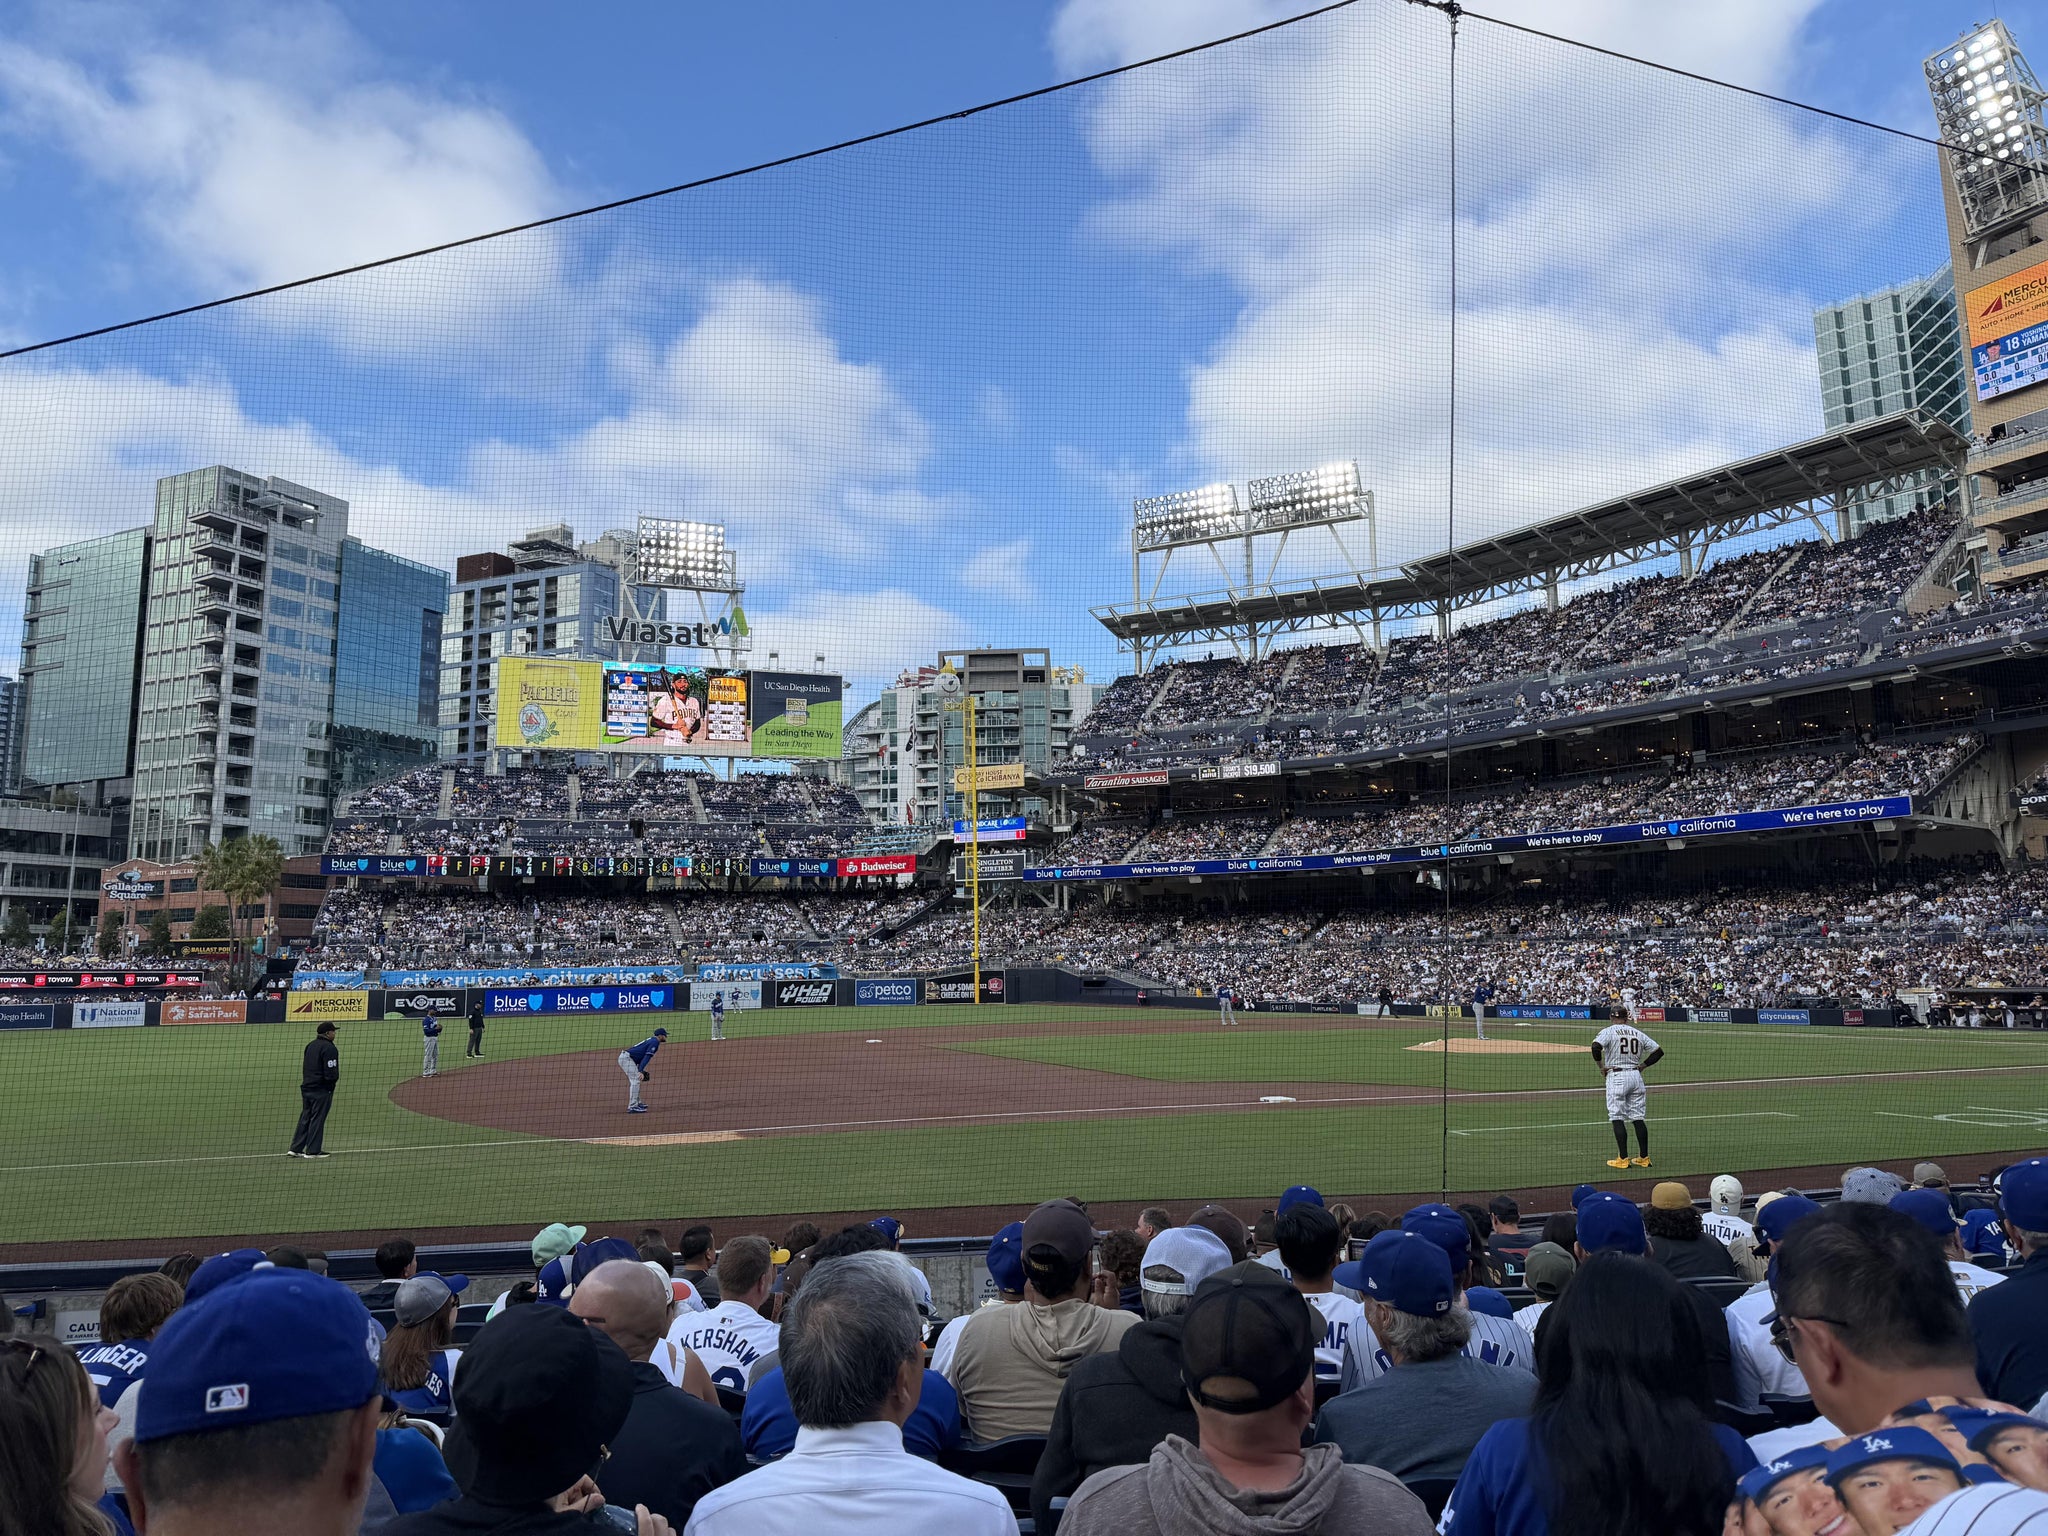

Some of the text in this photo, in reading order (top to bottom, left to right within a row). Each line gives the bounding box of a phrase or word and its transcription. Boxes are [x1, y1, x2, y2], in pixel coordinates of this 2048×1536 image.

[2005, 336, 2020, 352] 18
[1984, 371, 1997, 382] 0.0
[1994, 373, 2036, 395] 3 3
[607, 616, 708, 646] Viasat
[764, 682, 776, 690] UC
[790, 683, 808, 693] Diego
[809, 684, 830, 693] Health
[765, 728, 834, 740] Leading the Way
[792, 740, 812, 748] Diego
[1244, 763, 1276, 776] $19,500
[986, 773, 1020, 782] ICHIBANYA
[1086, 774, 1166, 788] Tarantino SAUSAGES
[1782, 804, 1885, 823] We're here to play
[1642, 818, 1736, 837] blue california
[1526, 832, 1602, 847] We're here to play
[1420, 841, 1492, 857] blue california
[442, 857, 448, 866] 2
[484, 857, 490, 866] 9
[527, 857, 532, 866] 2
[568, 857, 574, 866] 3
[608, 857, 614, 866] 6
[648, 858, 654, 867] 3
[725, 858, 730, 867] 0
[1333, 852, 1391, 864] We're here to play
[331, 859, 357, 868] blue
[380, 859, 405, 869] blue
[457, 861, 462, 871] F
[499, 861, 505, 871] F
[541, 861, 547, 871] F
[582, 862, 588, 871] 6
[622, 862, 628, 872] 6
[662, 862, 668, 871] 6
[701, 862, 706, 872] 5
[739, 862, 743, 872] 1
[759, 862, 780, 870] blue
[799, 862, 819, 870] blue
[861, 861, 906, 872] Budweiser
[1131, 863, 1195, 874] We're here to play
[1228, 858, 1302, 870] blue california
[441, 866, 447, 875] 6
[484, 866, 490, 875] 7
[526, 867, 532, 876] 4
[568, 867, 573, 876] 1
[608, 867, 614, 876] 2
[649, 867, 653, 876] 1
[725, 867, 730, 876] 0
[1036, 867, 1101, 879] blue california
[102, 882, 155, 893] Gallagher
[109, 891, 146, 900] Square
[798, 984, 833, 996] H2O
[875, 984, 911, 998] petco
[941, 983, 975, 991] SLAP SOME
[557, 994, 589, 1006] blue
[618, 992, 649, 1004] blue
[692, 990, 715, 1000] blue
[795, 996, 828, 1004] POWER
[941, 991, 960, 999] CHEESE
[314, 998, 362, 1006] MERCURY
[494, 995, 527, 1008] blue
[20, 1011, 45, 1020] Health
[100, 1007, 140, 1016] National
[188, 1009, 239, 1019] Safari Park
[1760, 1012, 1799, 1021] citycruises
[1620, 1037, 1638, 1055] 20
[681, 1328, 760, 1367] KERSHAW
